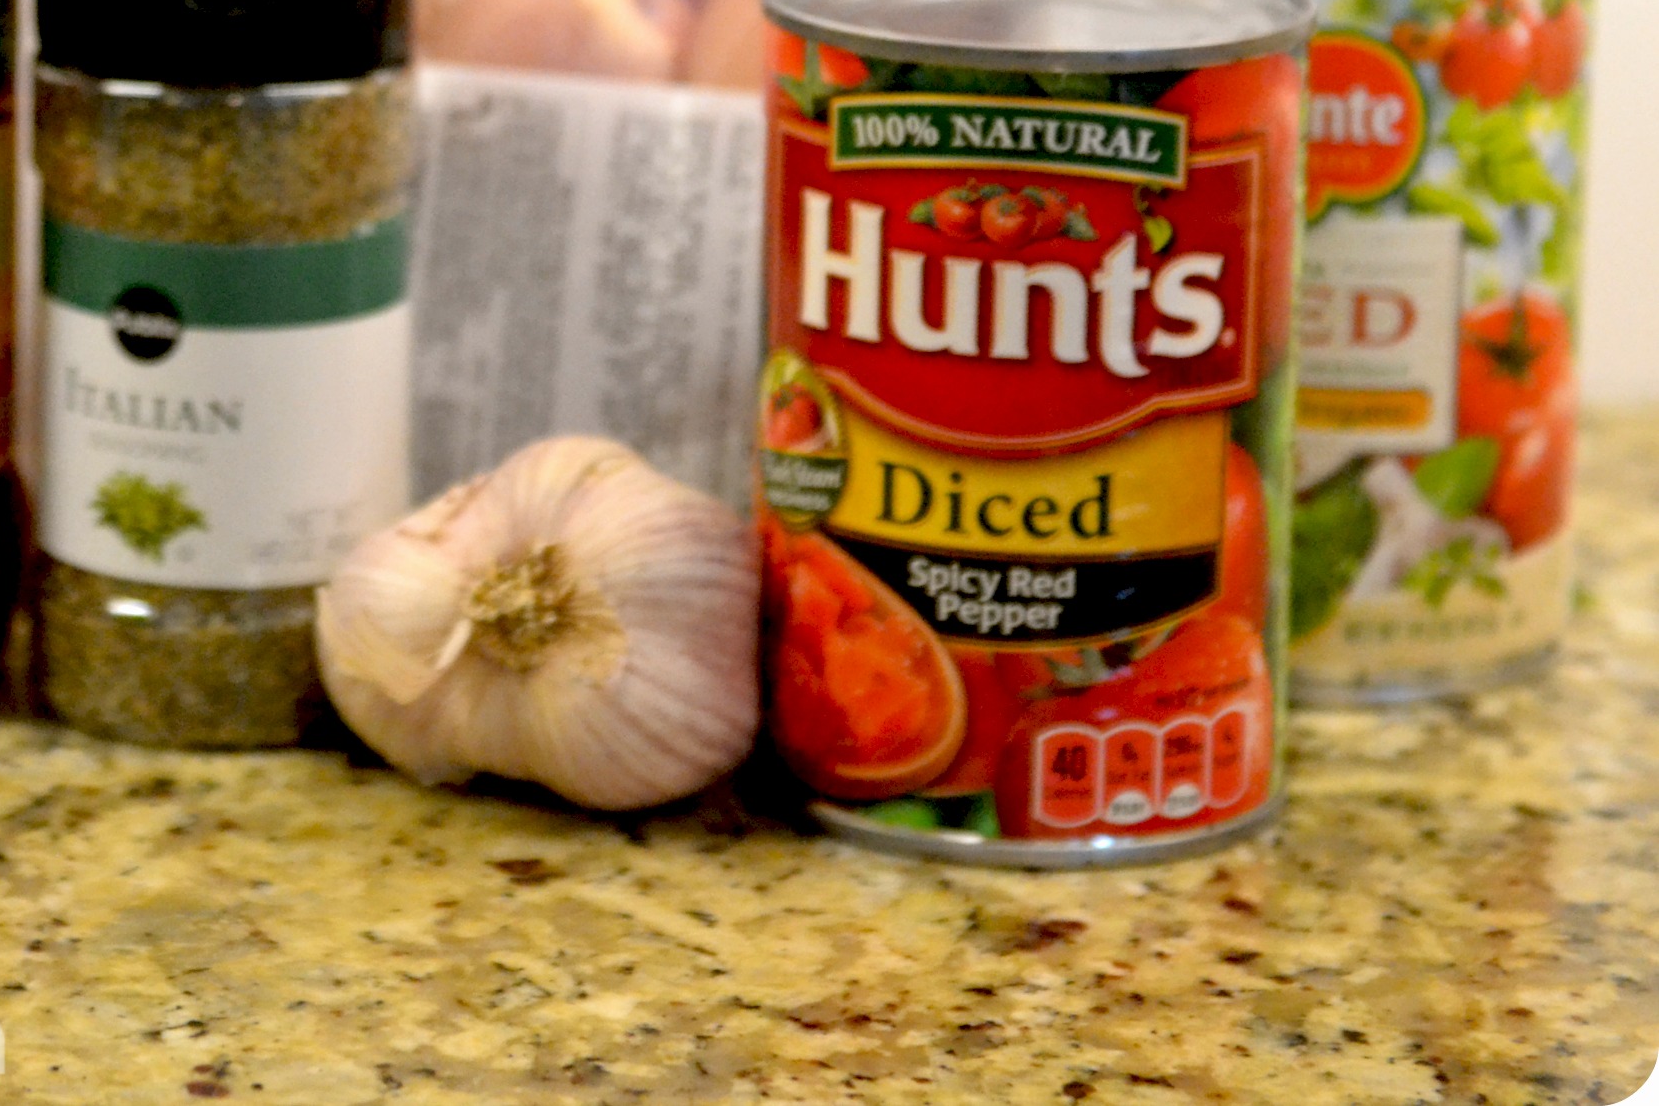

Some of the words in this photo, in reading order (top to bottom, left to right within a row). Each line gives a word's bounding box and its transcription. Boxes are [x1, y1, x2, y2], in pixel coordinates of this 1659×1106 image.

[851, 112, 940, 149] 100%
[949, 112, 1162, 165] NATURAL
[1310, 84, 1406, 147] nte
[64, 366, 245, 435] ITALIAN
[875, 462, 1114, 539] Diced
[906, 554, 1003, 603] Spicy
[1006, 564, 1077, 600] Red
[934, 592, 1064, 636] Pepper
[1051, 745, 1088, 782] 40
